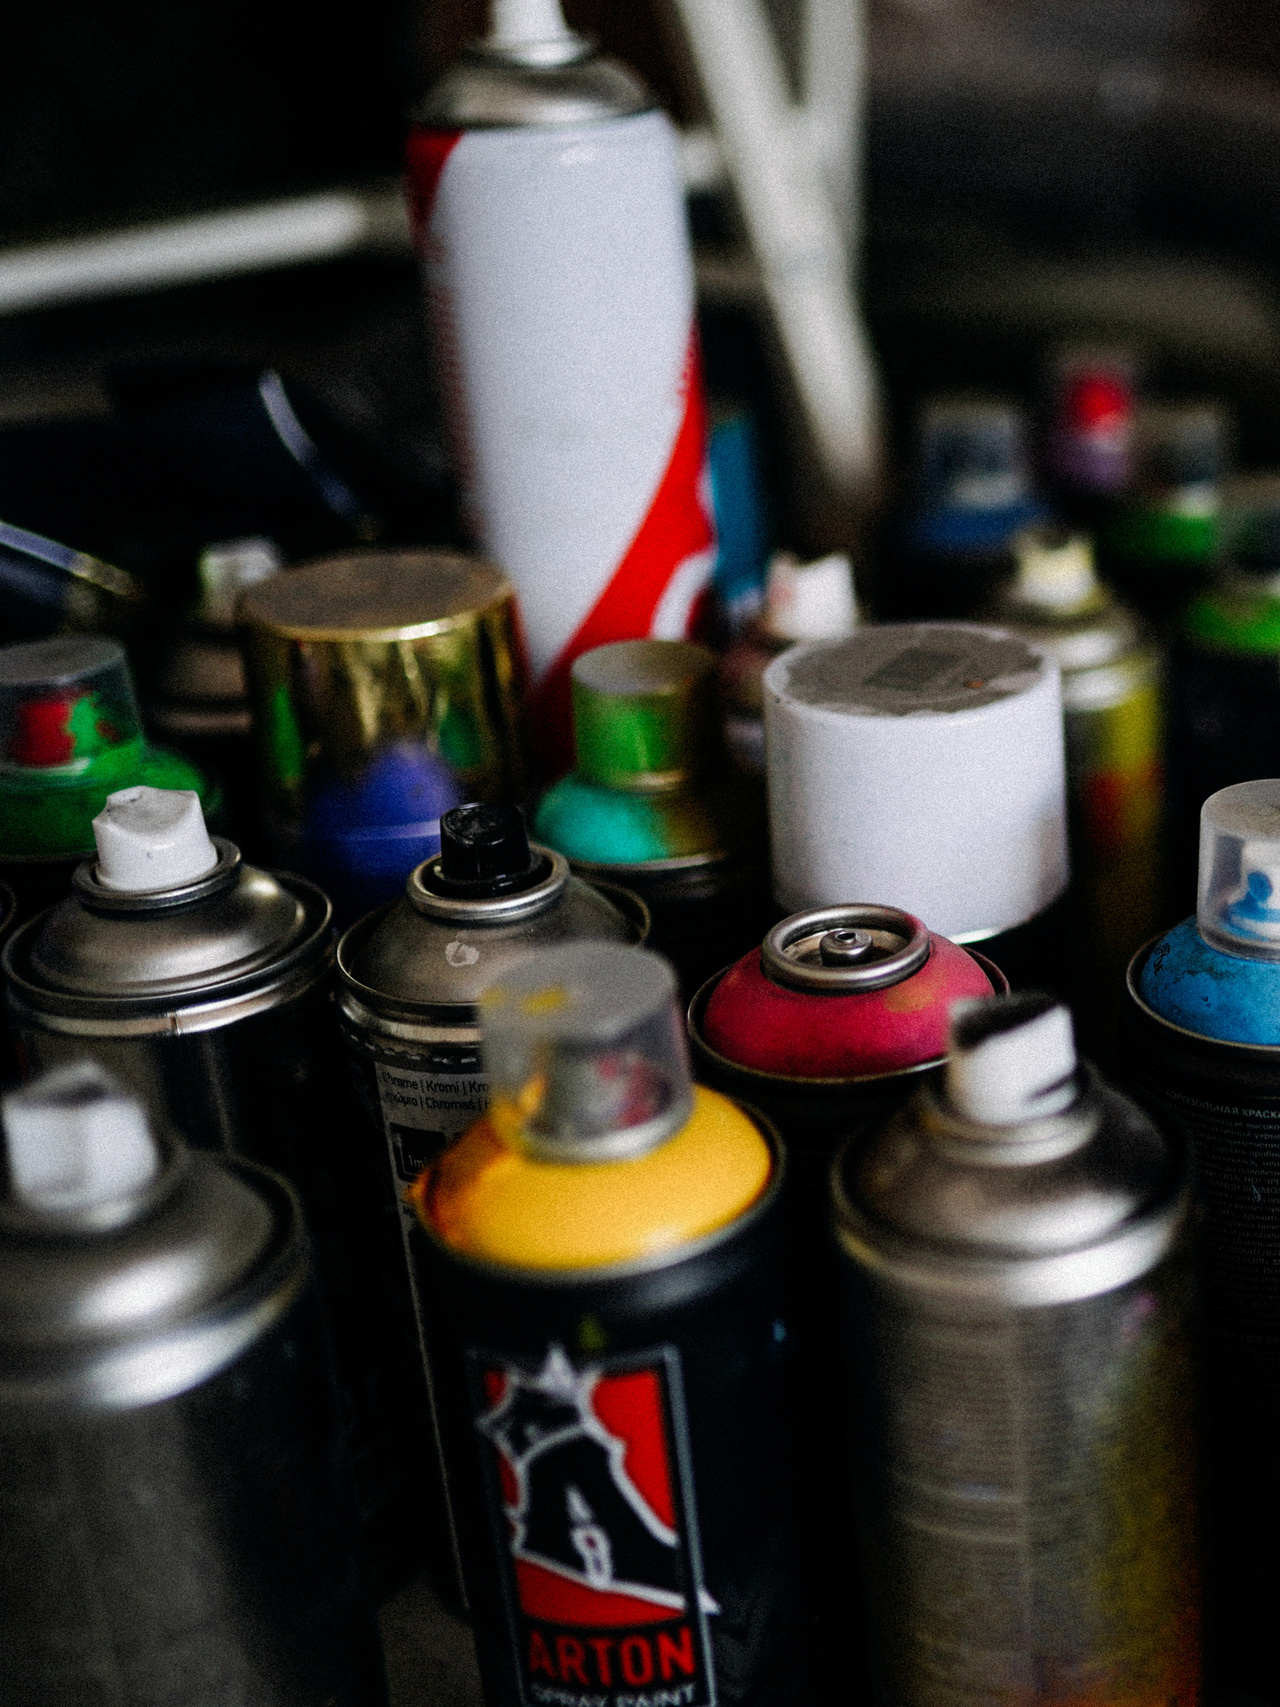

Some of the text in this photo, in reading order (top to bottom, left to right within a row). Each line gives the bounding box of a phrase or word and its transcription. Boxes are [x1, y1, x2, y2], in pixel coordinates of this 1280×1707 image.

[426, 1080, 460, 1094] Kromi
[468, 1081, 489, 1093] Kro
[1165, 1088, 1239, 1115] АЭРОЗОЛЬНАЯ
[528, 1626, 697, 1687] ARTON
[530, 1681, 697, 1707] SPRAY PAINT
